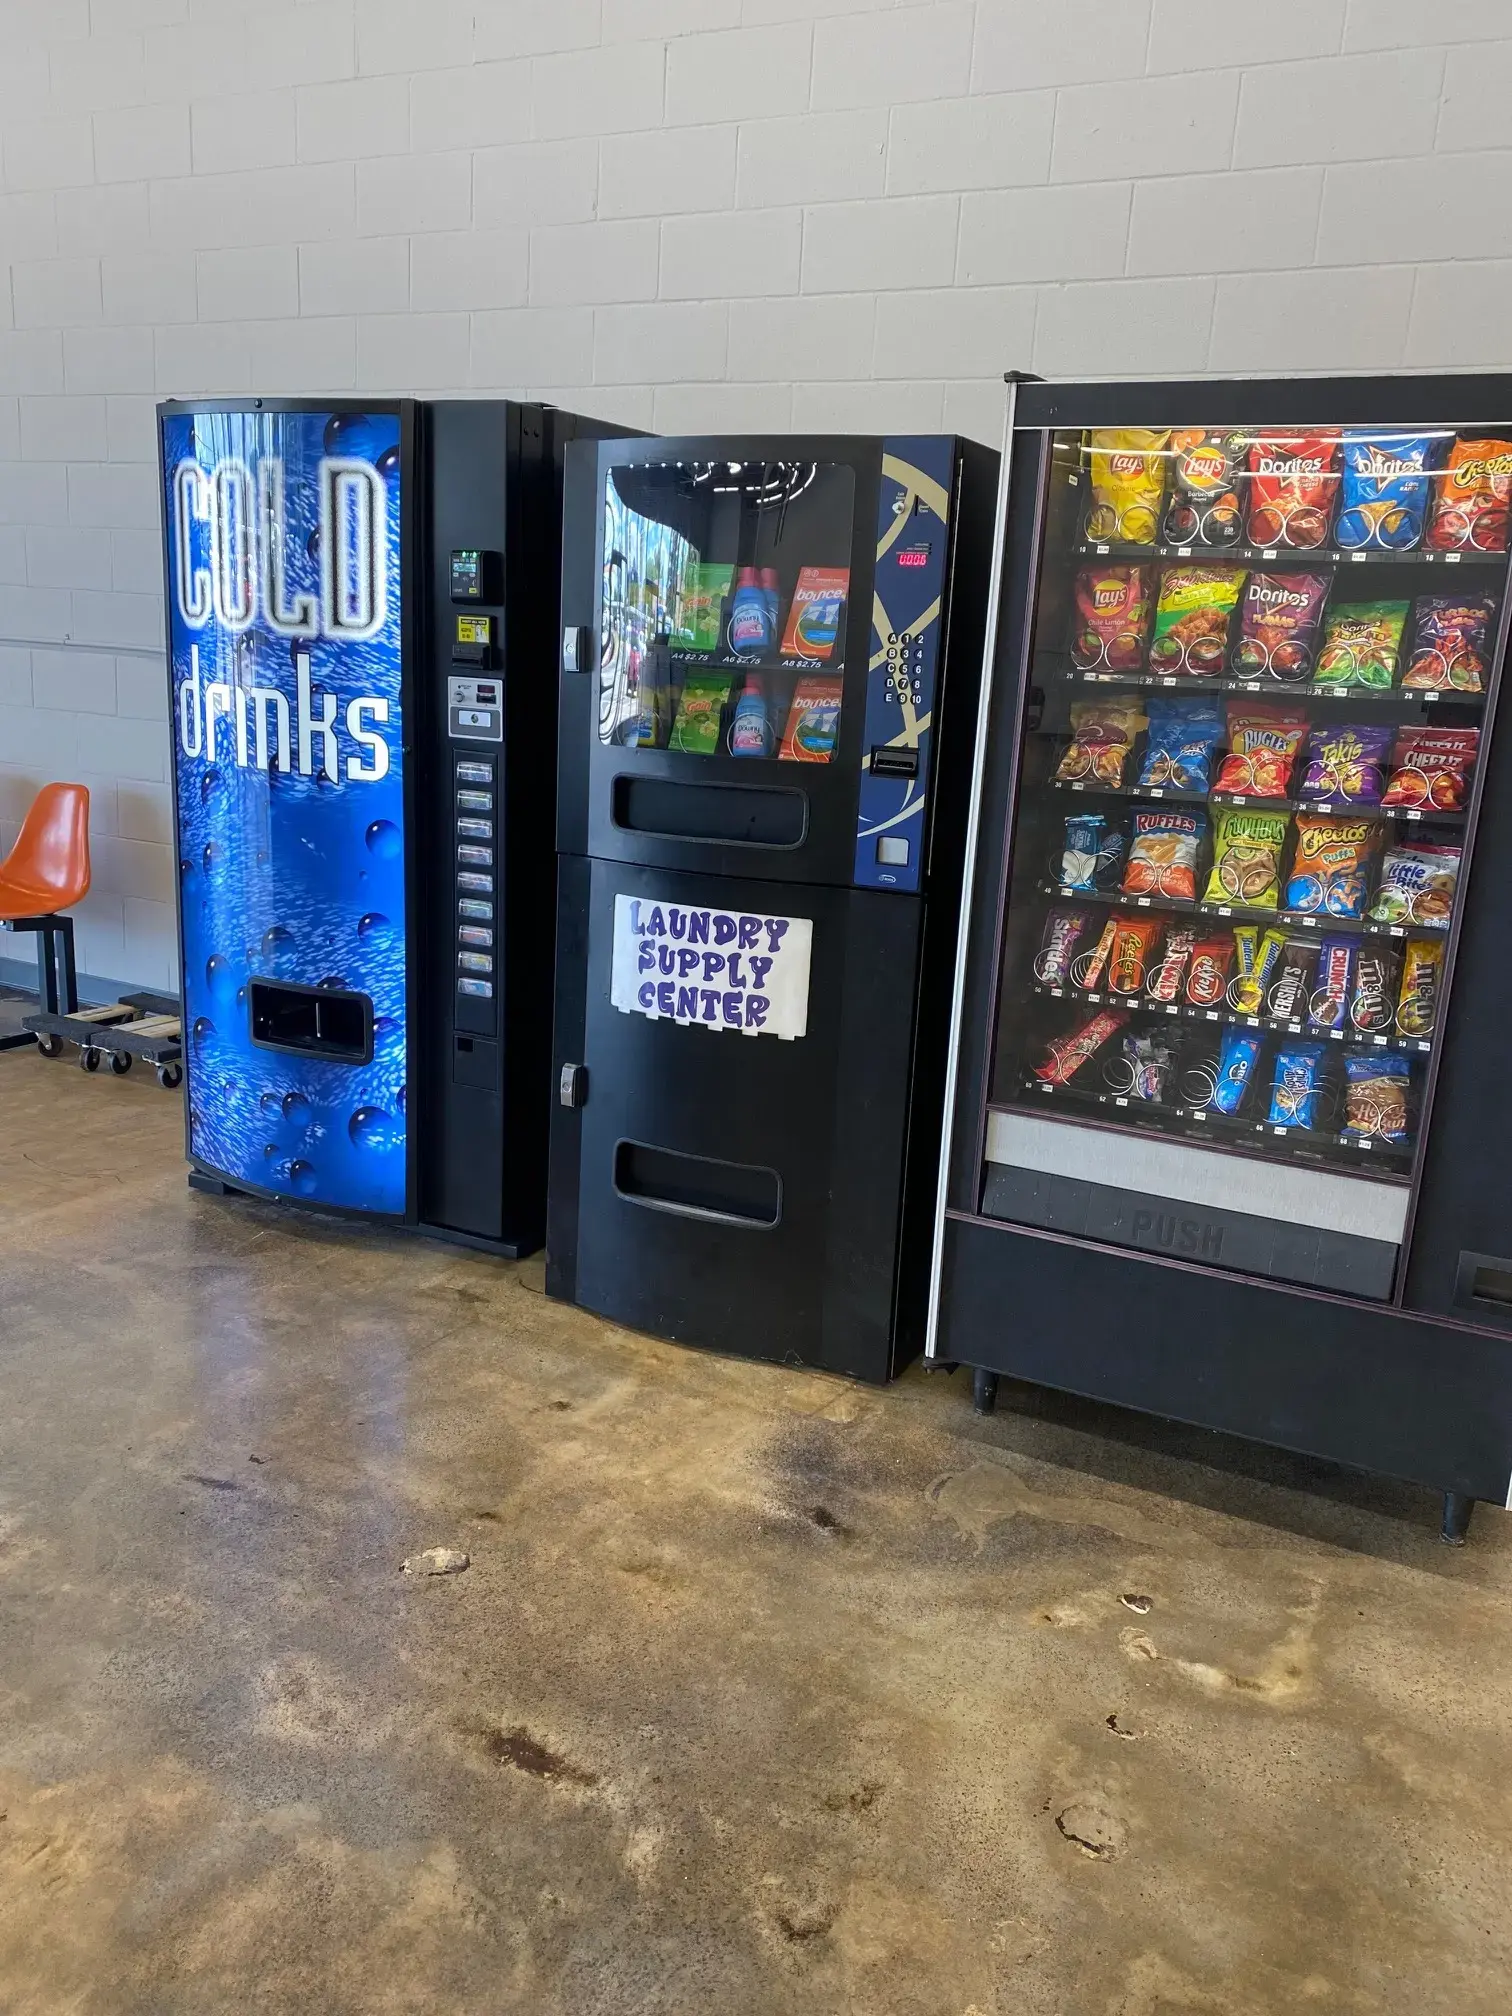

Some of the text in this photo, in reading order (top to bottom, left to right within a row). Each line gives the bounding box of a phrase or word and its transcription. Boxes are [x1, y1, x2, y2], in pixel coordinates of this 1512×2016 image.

[1112, 454, 1142, 474] Lay's
[1186, 458, 1222, 477] Lay's
[1260, 458, 1322, 474] Doritos
[1358, 458, 1423, 474] Doritos
[173, 457, 387, 640] COLD
[796, 588, 843, 601] bounce
[1094, 590, 1127, 608] Lay's
[1249, 585, 1310, 606] Doritos
[736, 615, 760, 624] Downy
[890, 634, 896, 642] A
[685, 653, 710, 661] $2.75
[736, 656, 761, 665] $2.75
[903, 650, 909, 658] 3
[796, 660, 821, 668] $2.75
[888, 664, 894, 672] C
[687, 701, 712, 712] Gain
[794, 698, 841, 708] bounce
[900, 695, 905, 703] 9
[912, 695, 921, 703] 10
[180, 643, 391, 785] drinks
[738, 724, 760, 733] Downy
[1244, 730, 1287, 753] BUGLES
[1320, 737, 1363, 768] Takis
[1137, 814, 1196, 832] RUFFLES
[1223, 814, 1285, 842] FUNYUNS
[1302, 825, 1368, 856] Cheetos
[1322, 848, 1355, 864] Puffs
[1388, 864, 1426, 878] Little
[1395, 876, 1432, 890] Bites
[630, 900, 789, 952] LAUNDRY
[1042, 918, 1070, 980] Skittles
[1124, 932, 1143, 974] Reese's
[638, 939, 773, 989] SUPPLY
[1330, 948, 1347, 1002] CRUNCH
[638, 981, 770, 1028] CENTER
[1131, 1209, 1225, 1260] PUSH
